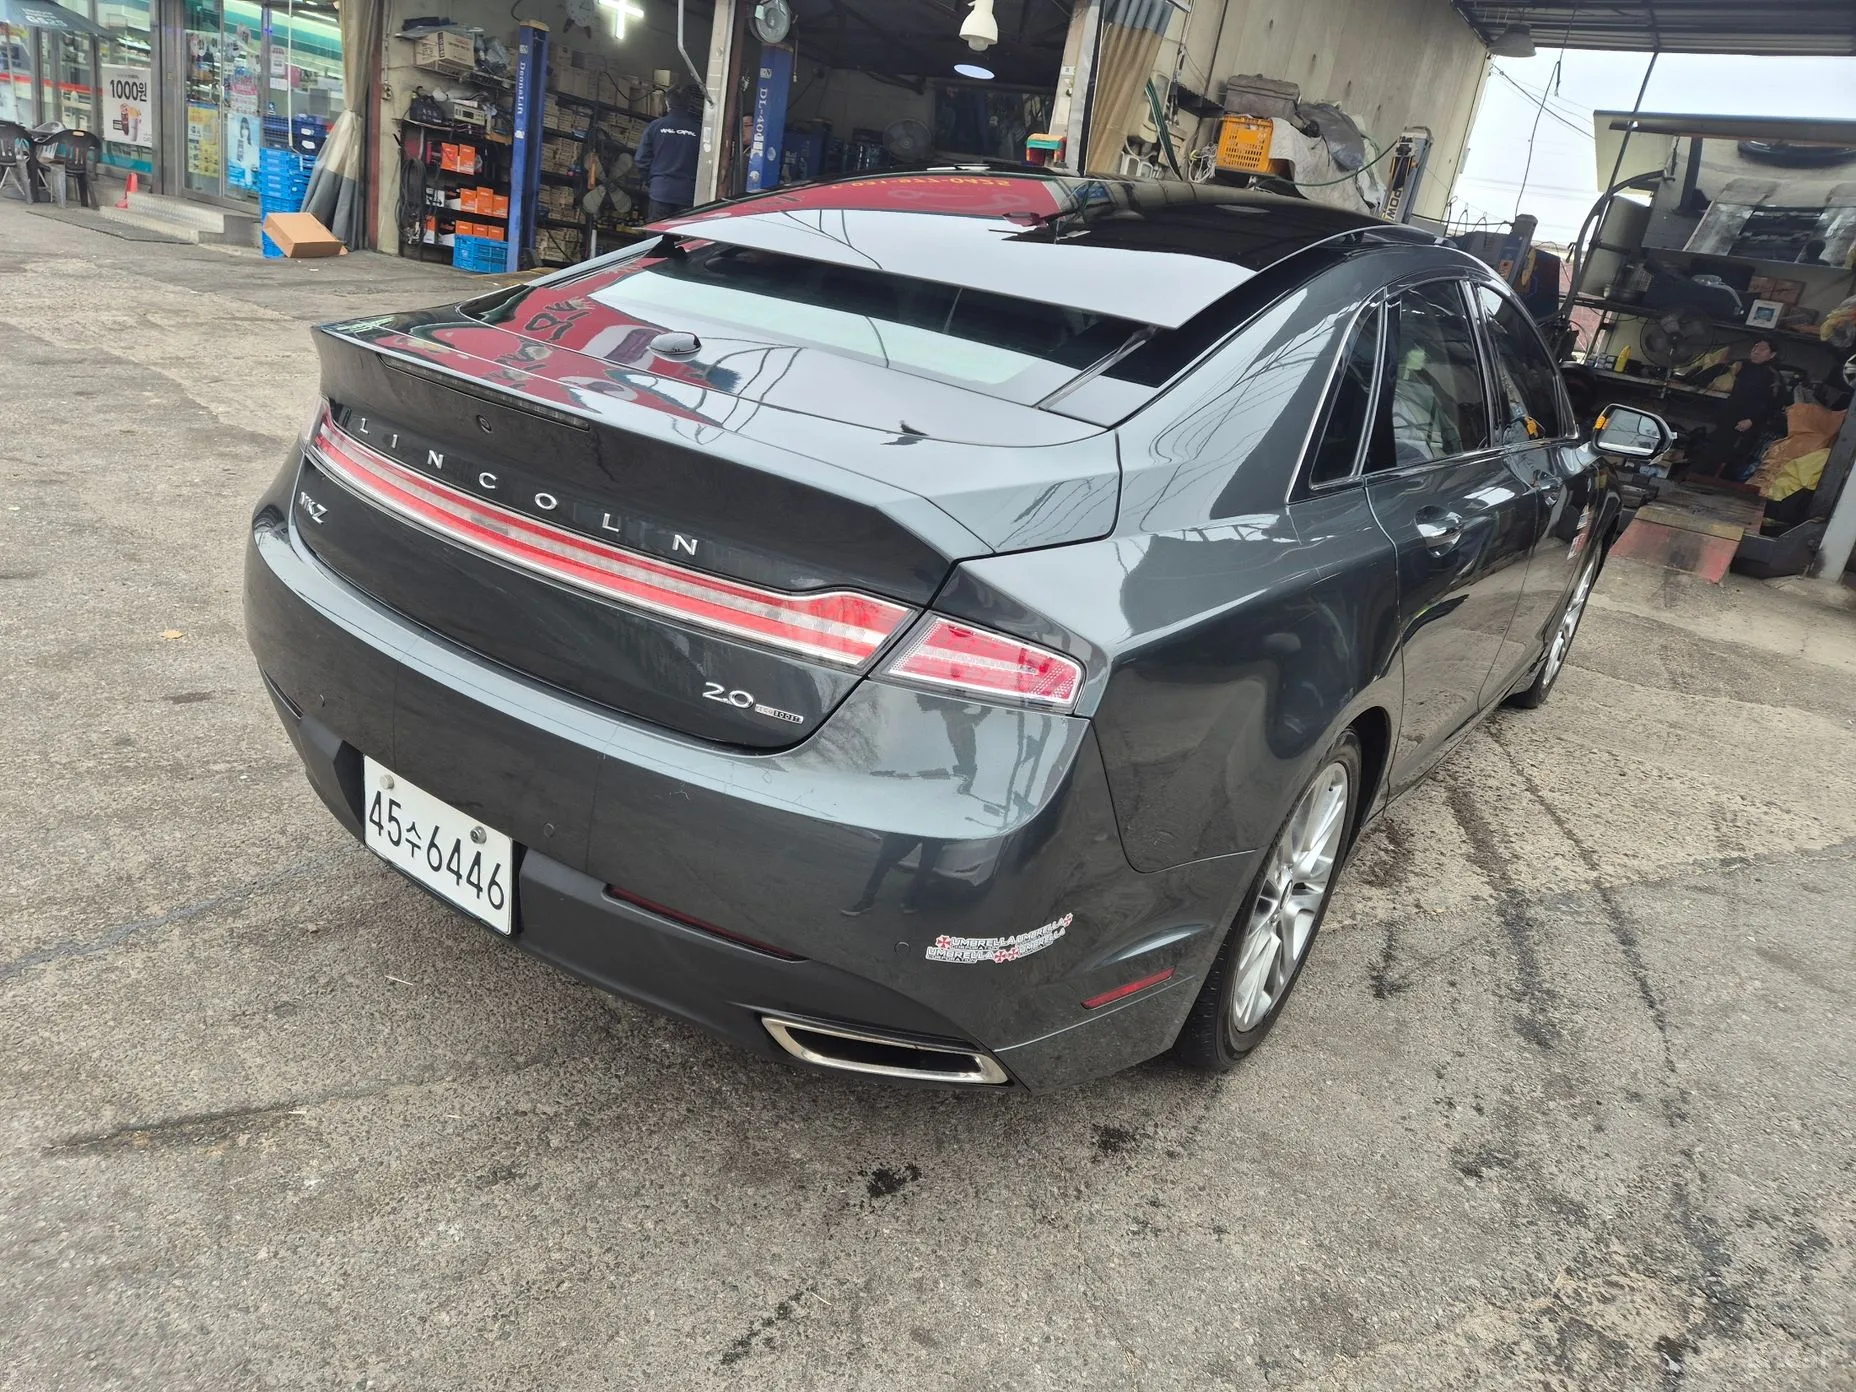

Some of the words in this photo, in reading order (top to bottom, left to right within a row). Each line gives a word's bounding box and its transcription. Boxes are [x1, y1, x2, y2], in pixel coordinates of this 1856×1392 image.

[110, 80, 148, 102] 1000원
[359, 417, 699, 557] LINCOLN
[299, 491, 328, 525] MKZ
[702, 681, 755, 709] 2.0
[368, 790, 505, 911] 45수6446
[927, 947, 994, 961] UMBRELLA
